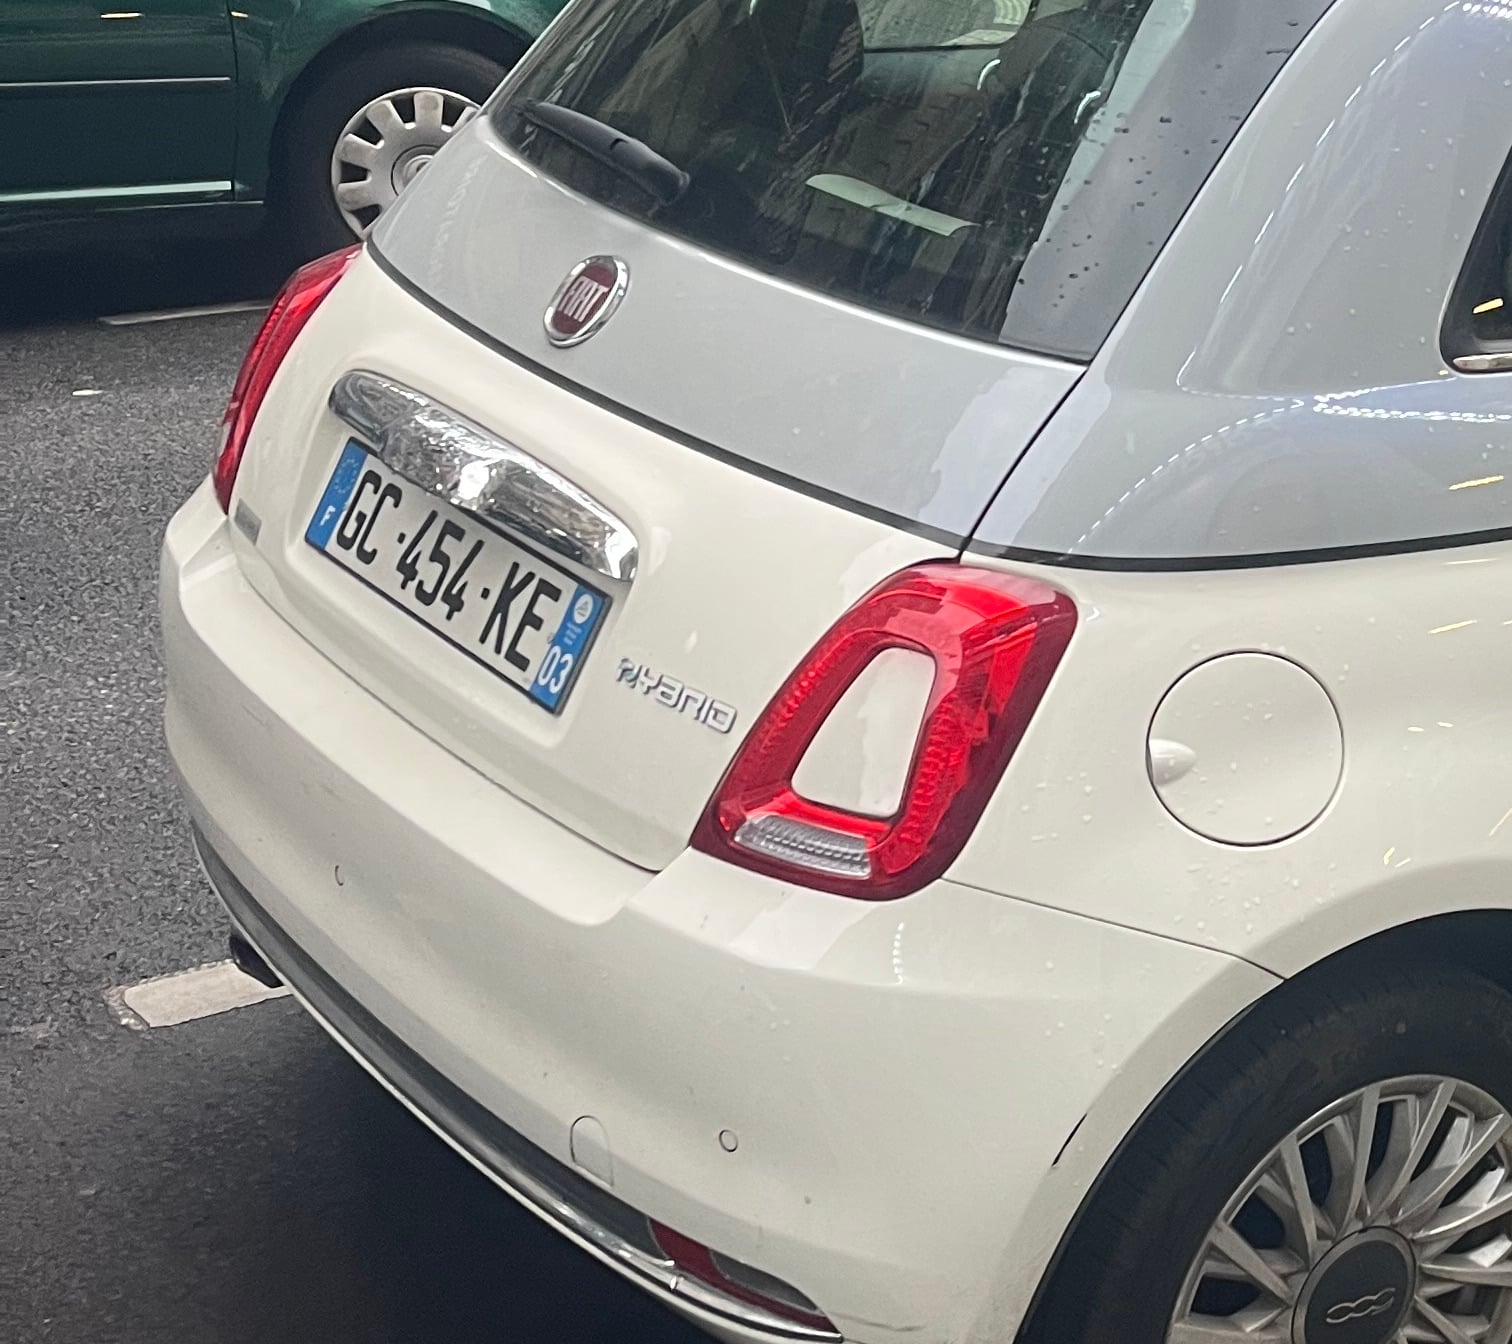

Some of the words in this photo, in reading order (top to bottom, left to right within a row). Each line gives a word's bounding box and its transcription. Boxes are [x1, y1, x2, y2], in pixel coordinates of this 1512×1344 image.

[558, 275, 611, 323] FIAT
[319, 505, 336, 527] F
[537, 645, 574, 694] 03
